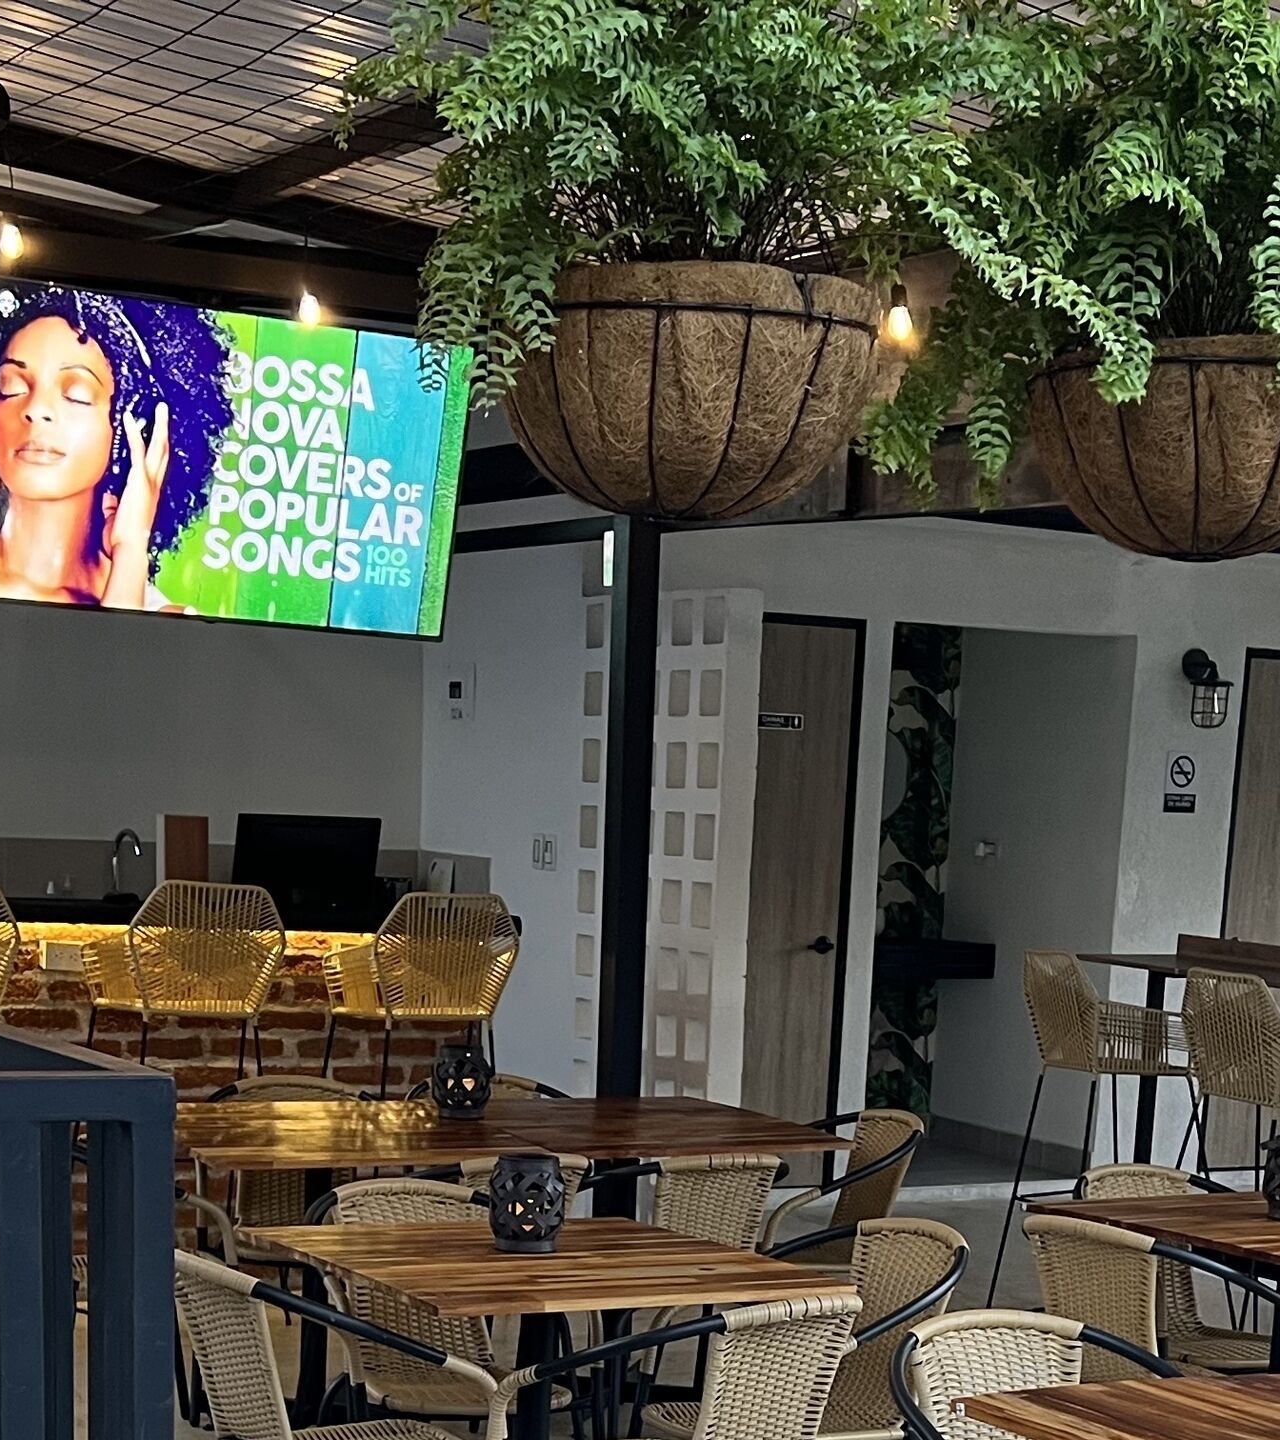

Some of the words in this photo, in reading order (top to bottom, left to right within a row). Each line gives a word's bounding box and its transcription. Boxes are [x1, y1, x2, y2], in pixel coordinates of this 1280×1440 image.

[225, 350, 375, 412] BOSSA
[211, 440, 393, 500] COVERS
[393, 482, 424, 504] OF
[208, 483, 424, 547] POPULAR
[201, 527, 362, 582] SONGS
[364, 565, 412, 588] HITS
[366, 544, 409, 567] 100
